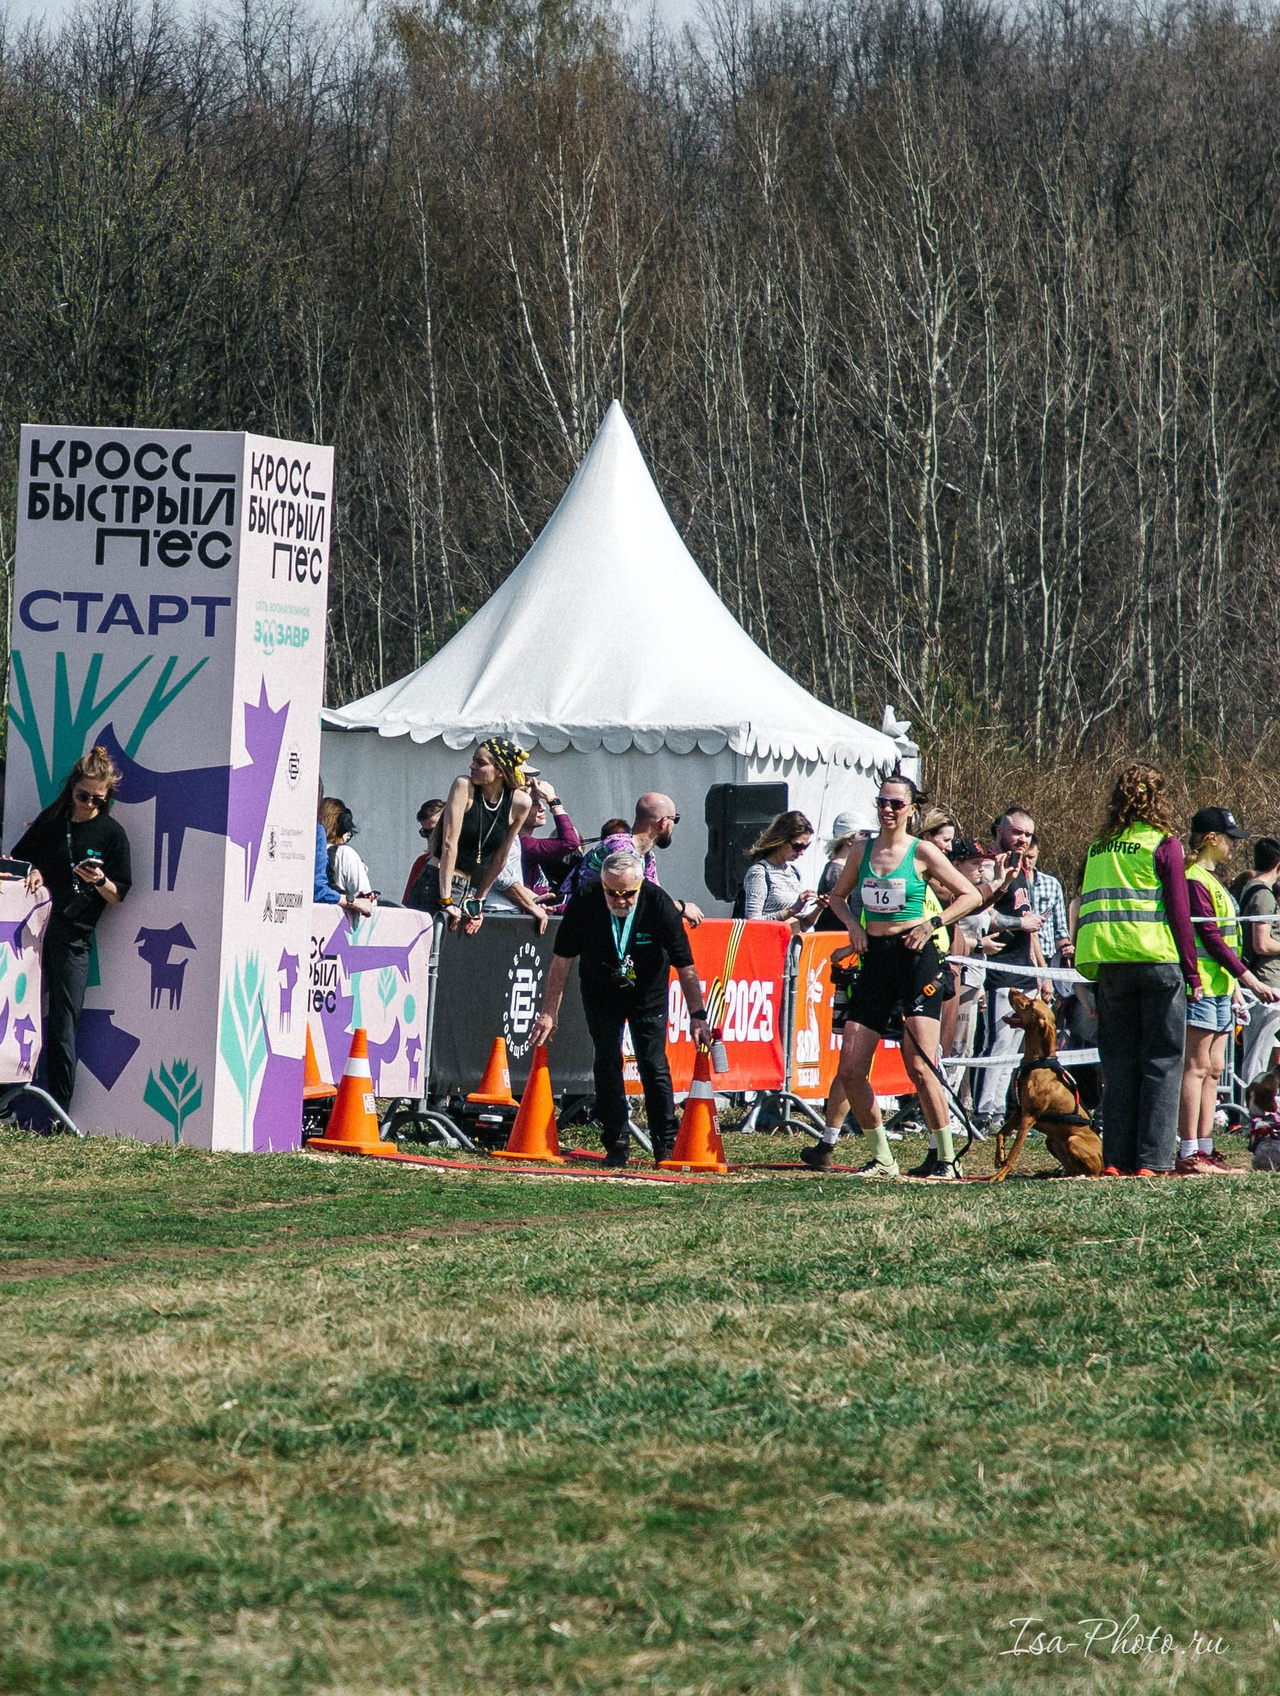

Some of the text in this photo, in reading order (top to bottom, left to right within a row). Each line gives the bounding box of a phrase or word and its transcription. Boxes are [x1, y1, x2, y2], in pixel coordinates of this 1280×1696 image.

[30, 439, 193, 482] КРОСС
[250, 451, 312, 498] КРОСС
[19, 589, 232, 637] СТАРТ
[874, 891, 890, 905] 16
[722, 979, 774, 1042] 2025
